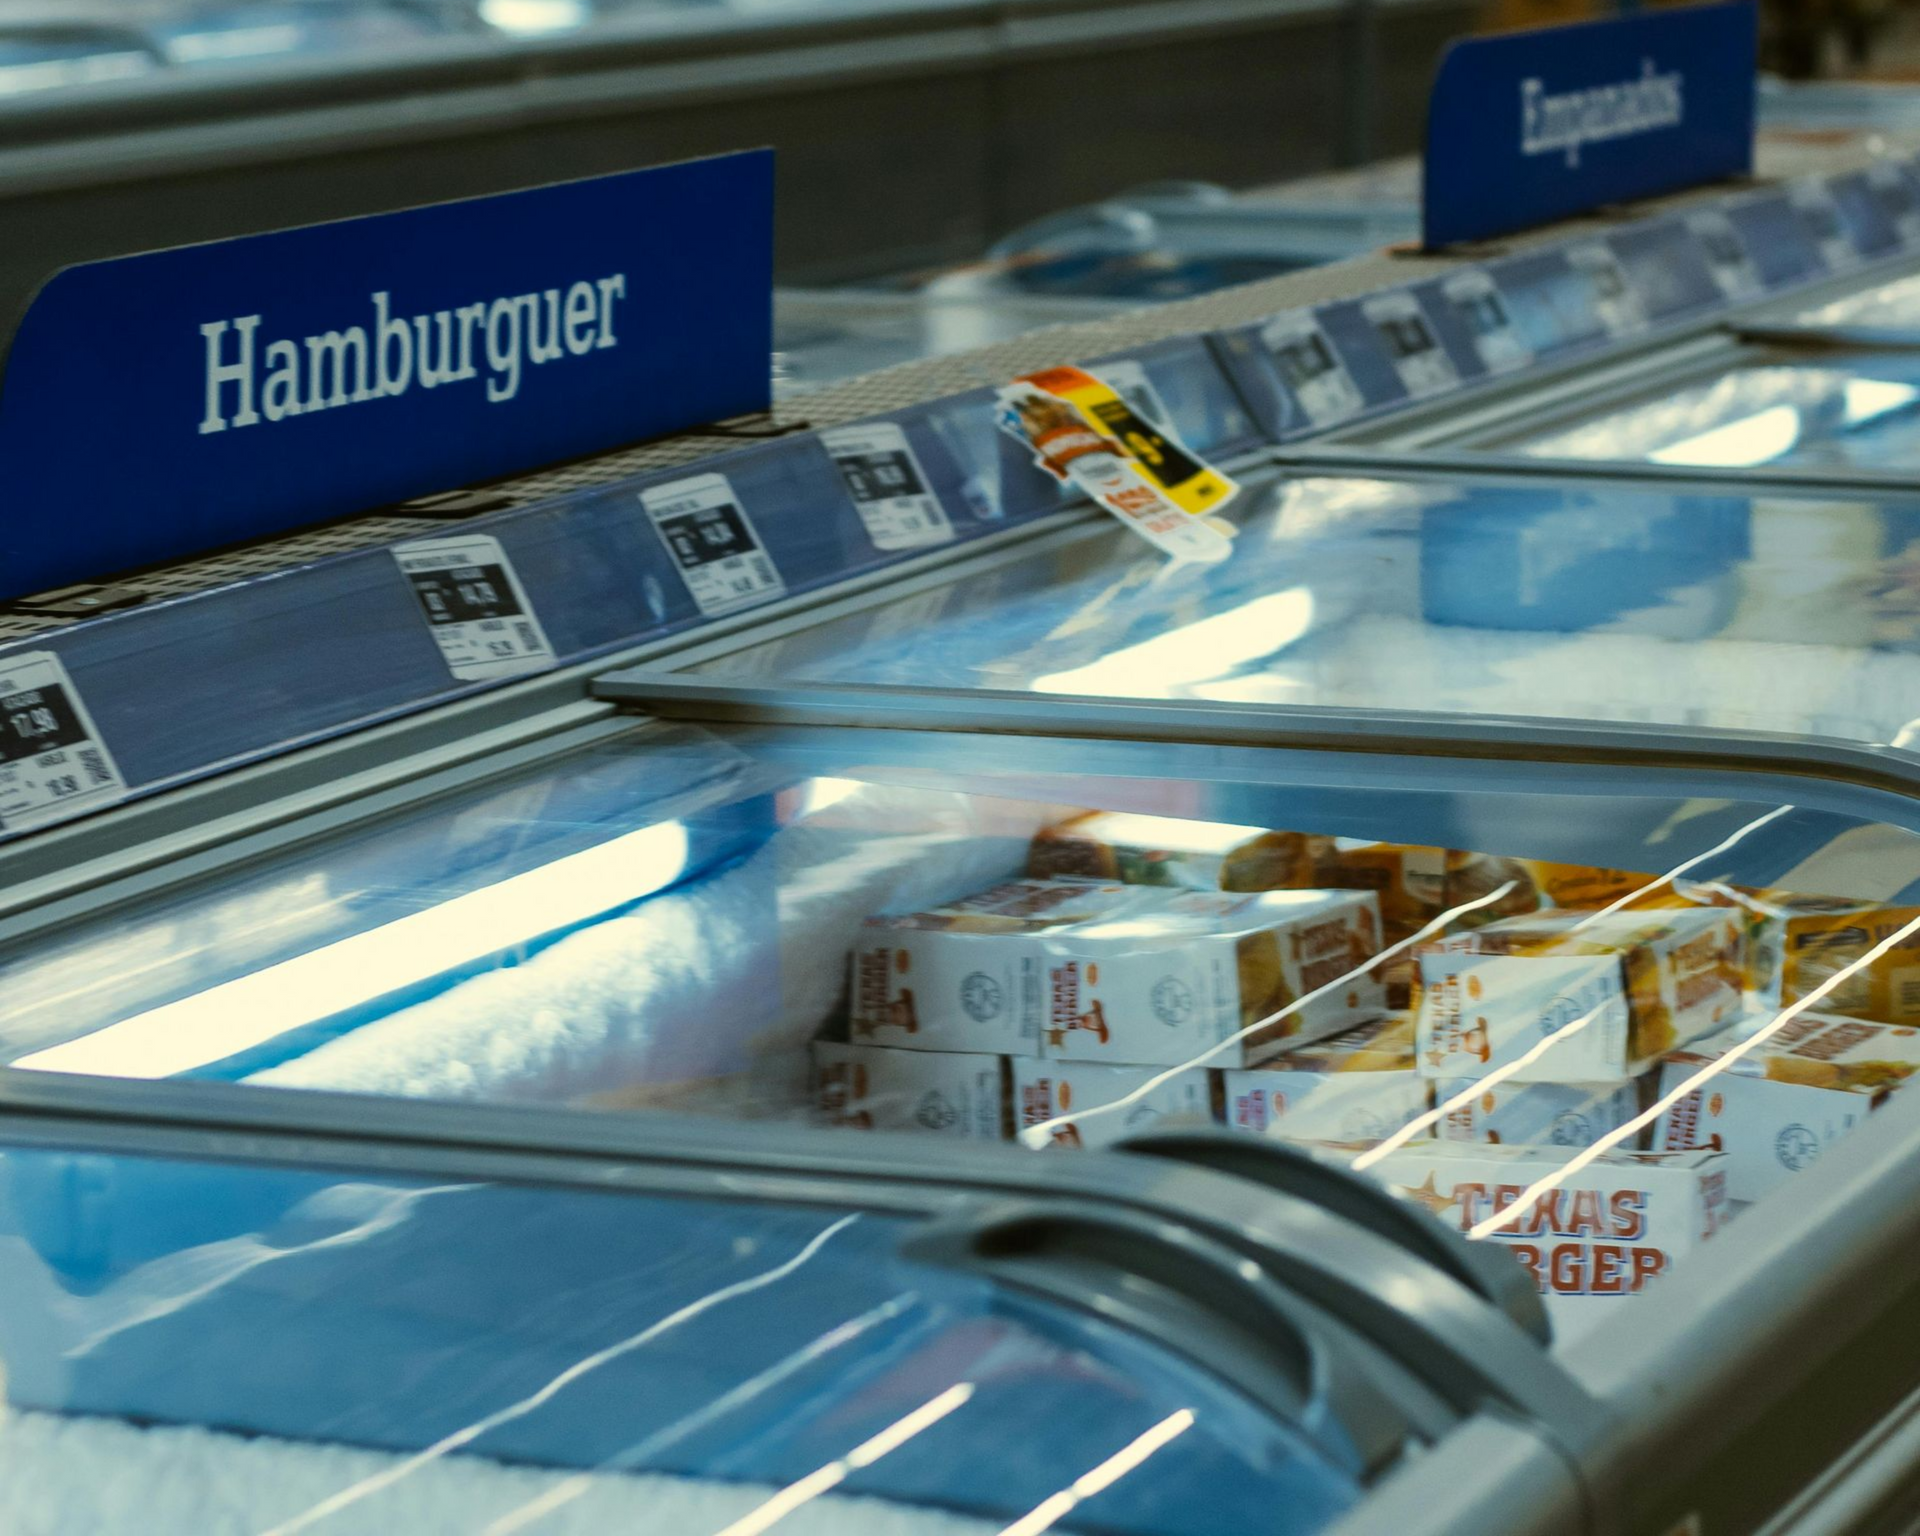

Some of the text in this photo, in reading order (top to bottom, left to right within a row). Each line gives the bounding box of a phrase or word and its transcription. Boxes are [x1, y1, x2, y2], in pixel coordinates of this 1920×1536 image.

[199, 274, 625, 434] Hamburguer
[1453, 1182, 1651, 1241] TEXAS
[1509, 1243, 1670, 1296] RGER
